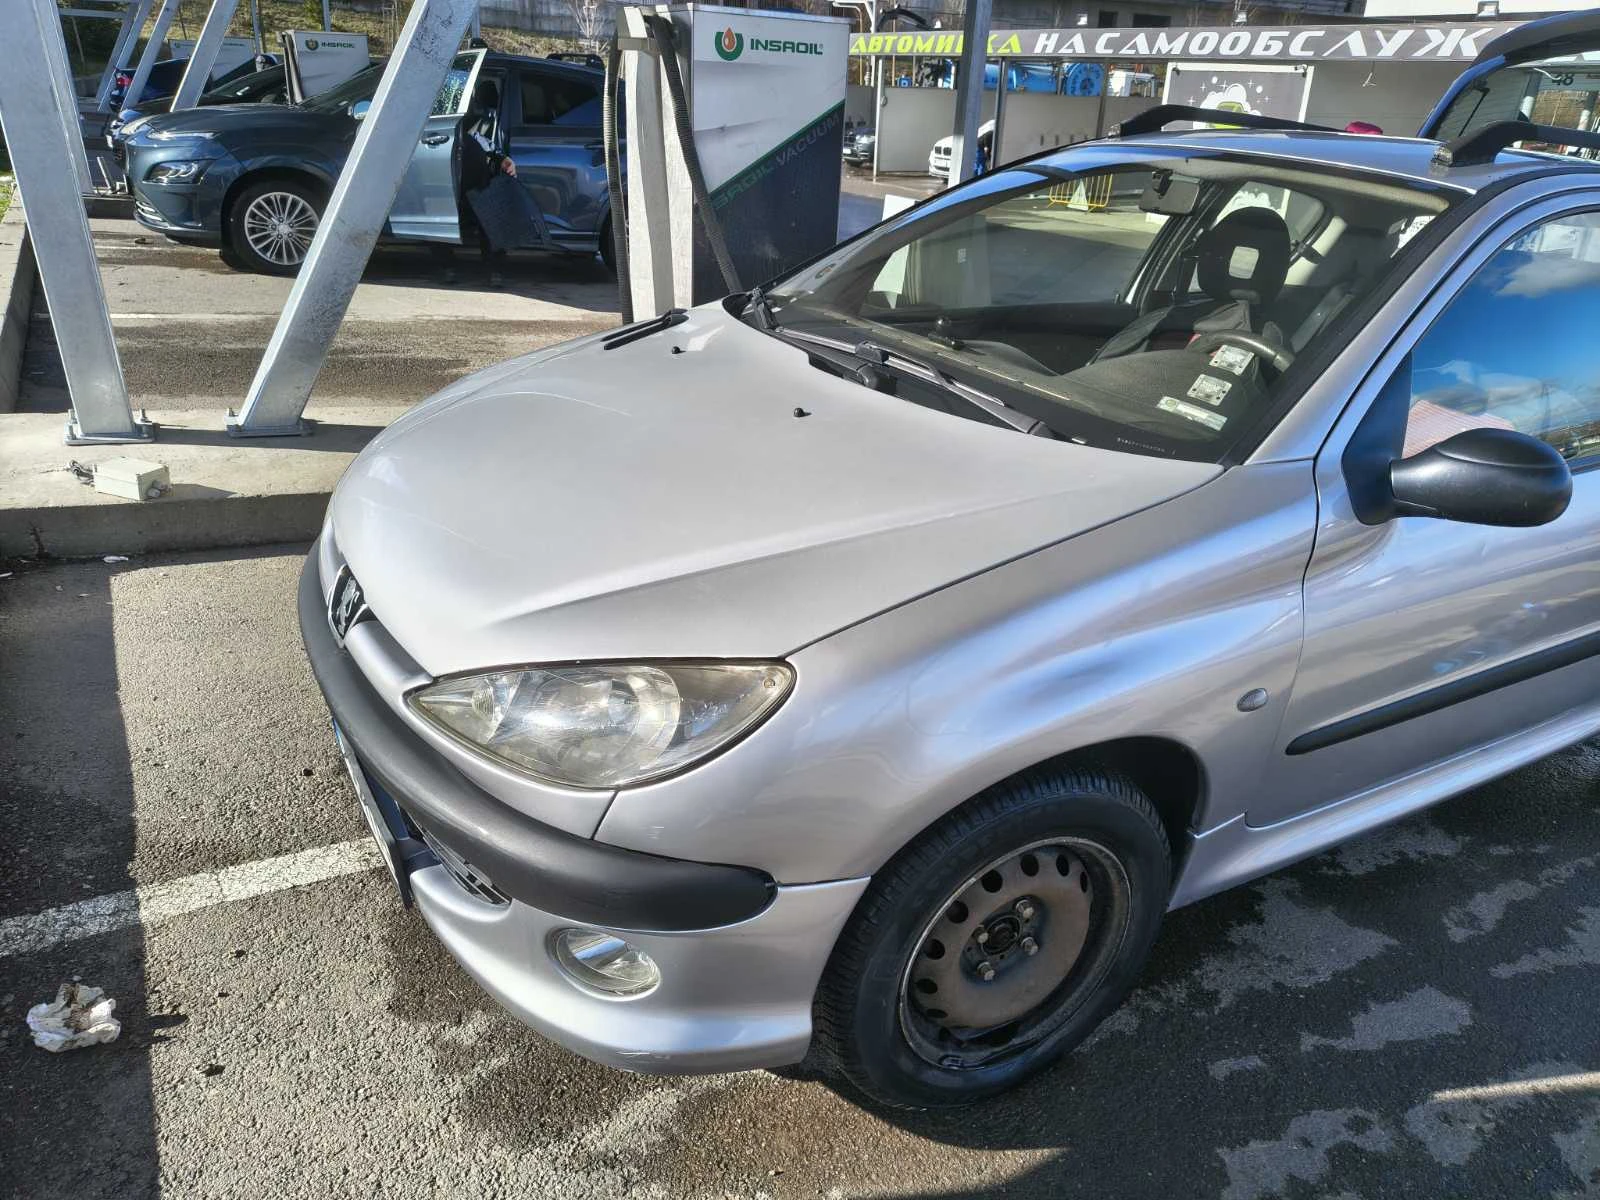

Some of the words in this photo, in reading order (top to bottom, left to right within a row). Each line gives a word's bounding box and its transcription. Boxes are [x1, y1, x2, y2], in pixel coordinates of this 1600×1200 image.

[750, 38, 823, 55] INSAOIL
[1032, 33, 1087, 54] НА
[1095, 27, 1516, 57] САМООБСЛУЖ
[776, 112, 841, 166] VACUUM
